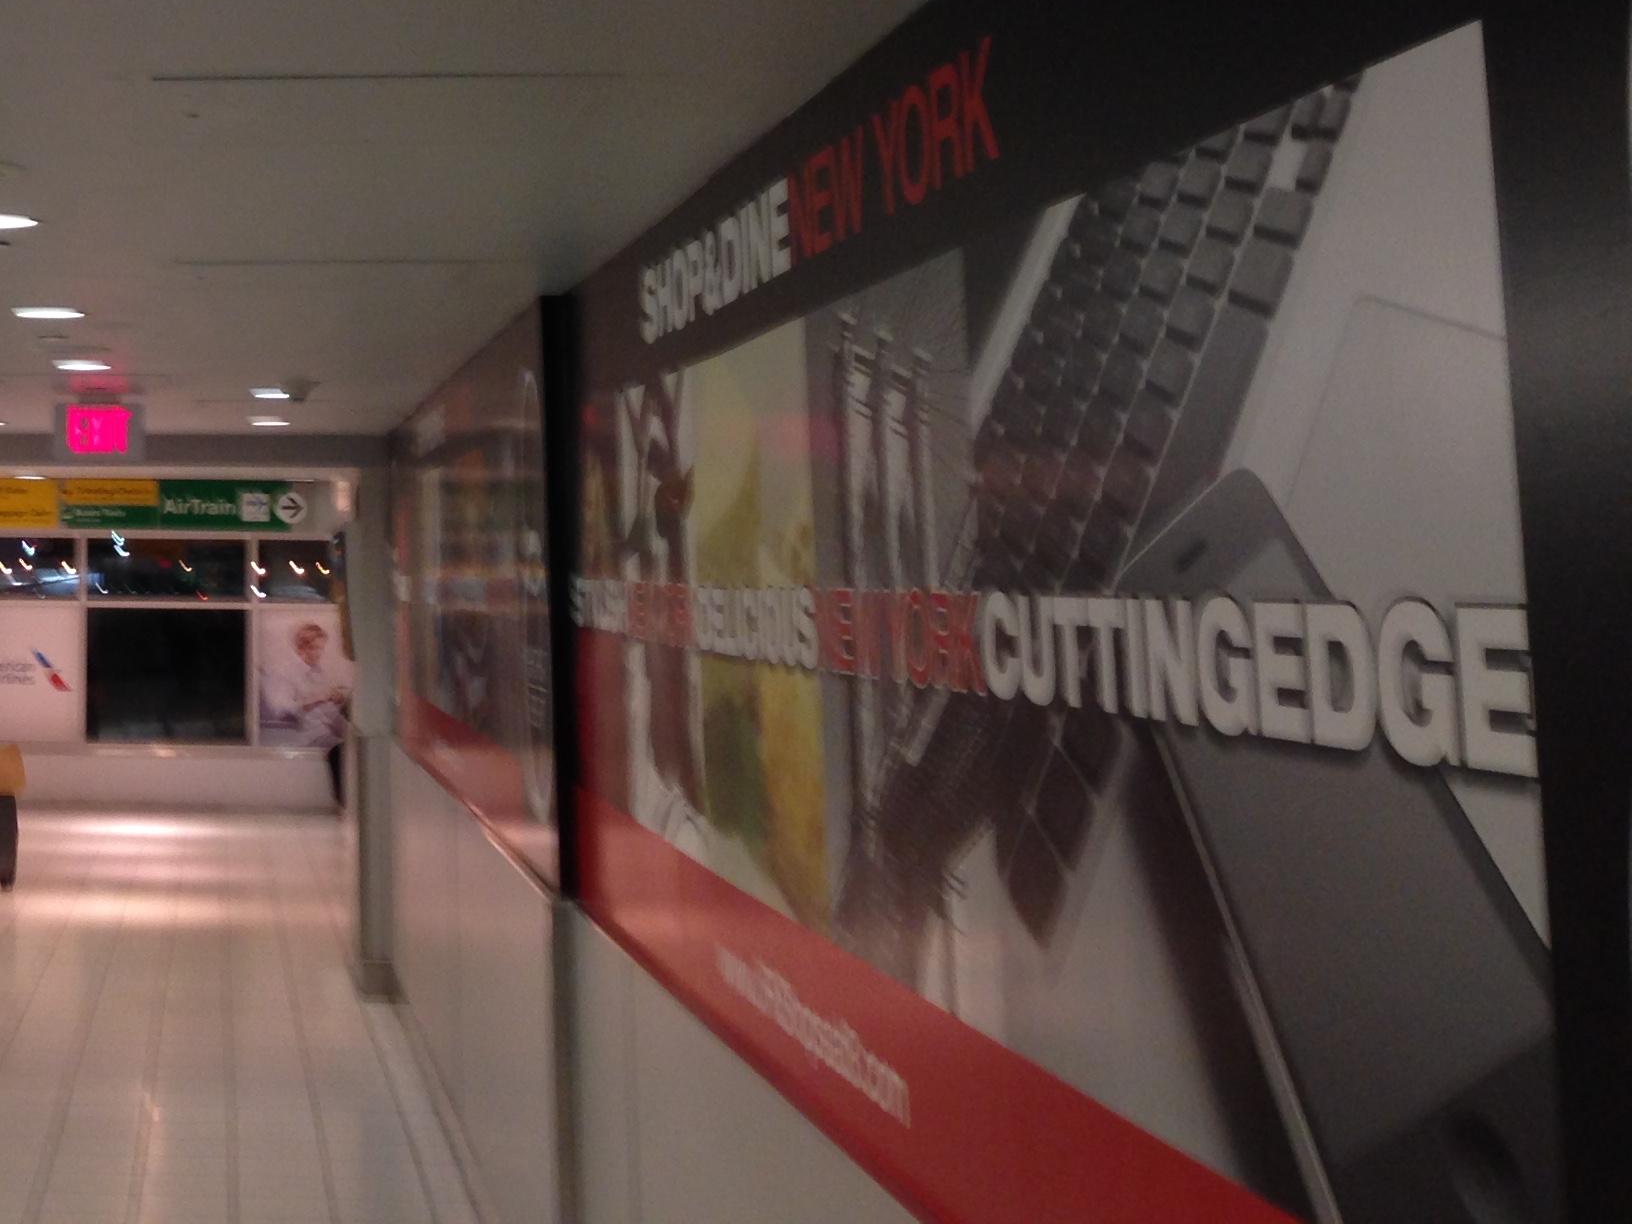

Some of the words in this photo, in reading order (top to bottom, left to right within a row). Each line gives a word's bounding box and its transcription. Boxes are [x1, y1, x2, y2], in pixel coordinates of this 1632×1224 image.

[787, 124, 865, 268] NEW
[871, 35, 1001, 217] YORK
[162, 492, 237, 515] AirTrain
